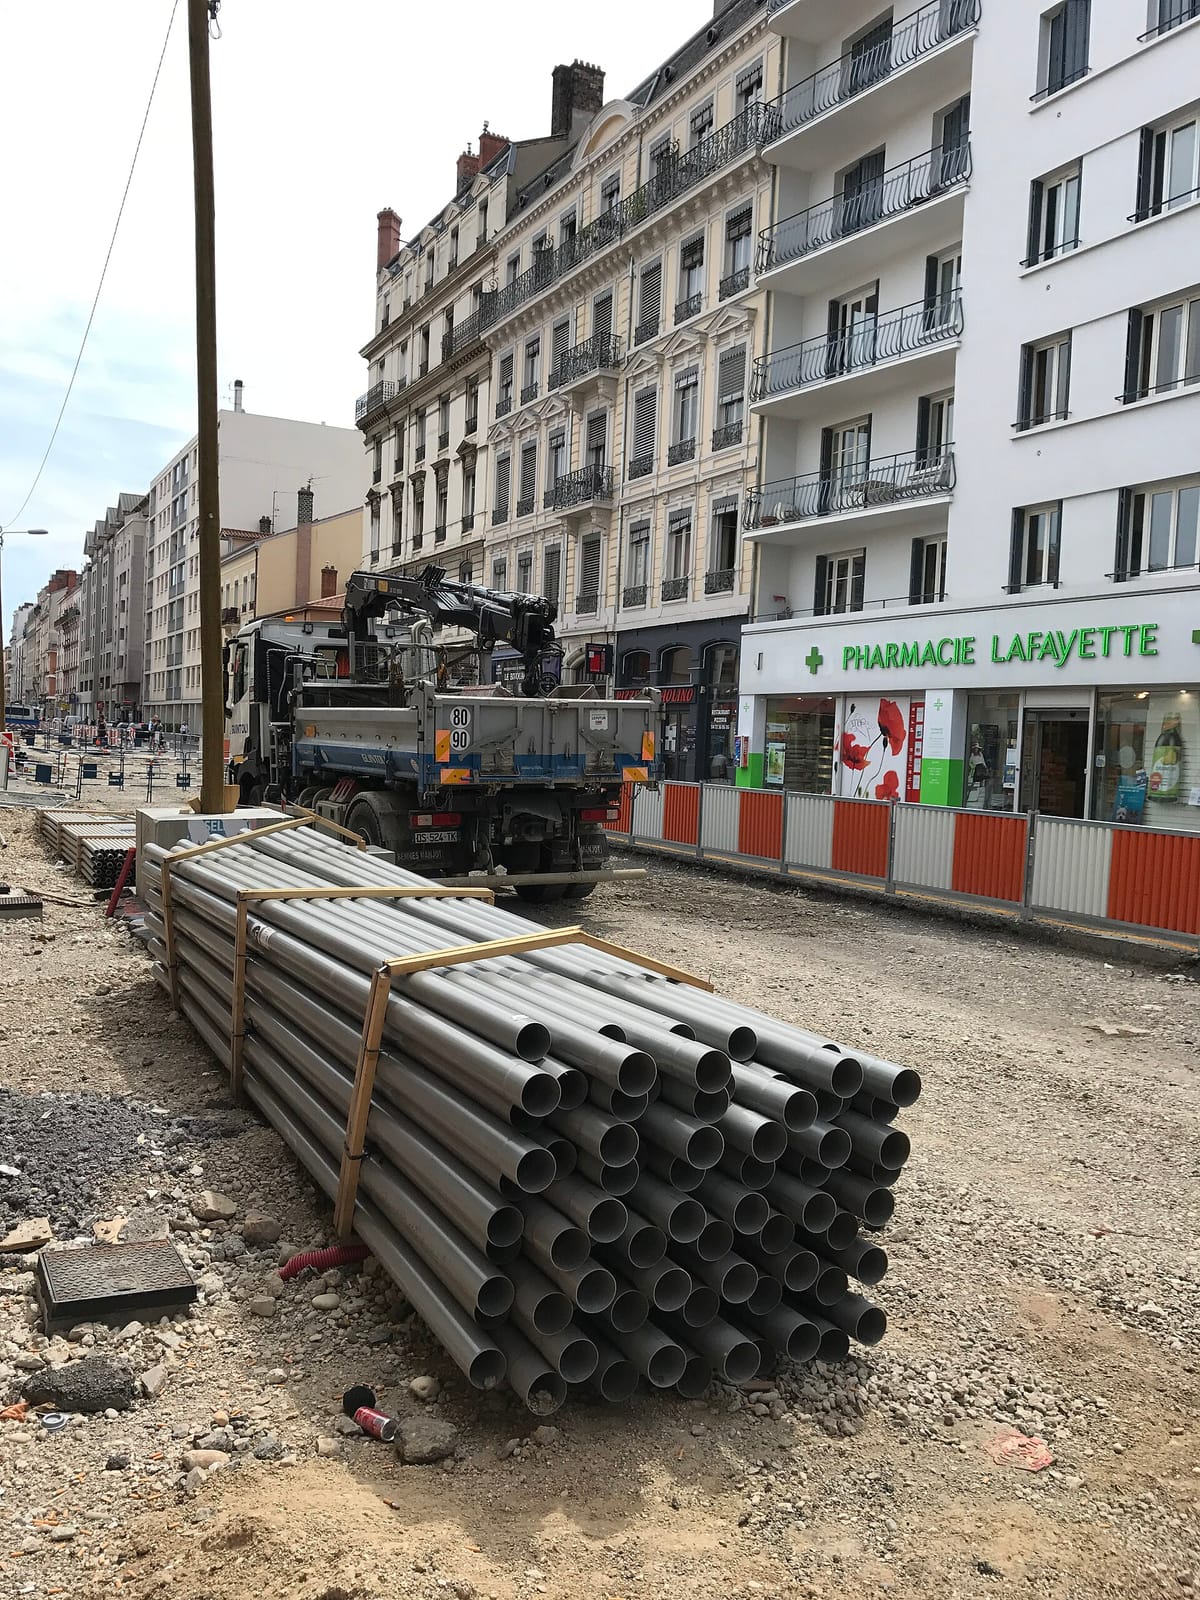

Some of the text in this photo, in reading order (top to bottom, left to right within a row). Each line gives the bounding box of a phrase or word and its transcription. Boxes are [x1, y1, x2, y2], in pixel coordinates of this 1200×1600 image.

[842, 623, 1159, 671] PHARMACIE LAFAYETTE
[453, 708, 469, 726] 80
[452, 730, 468, 749] 90
